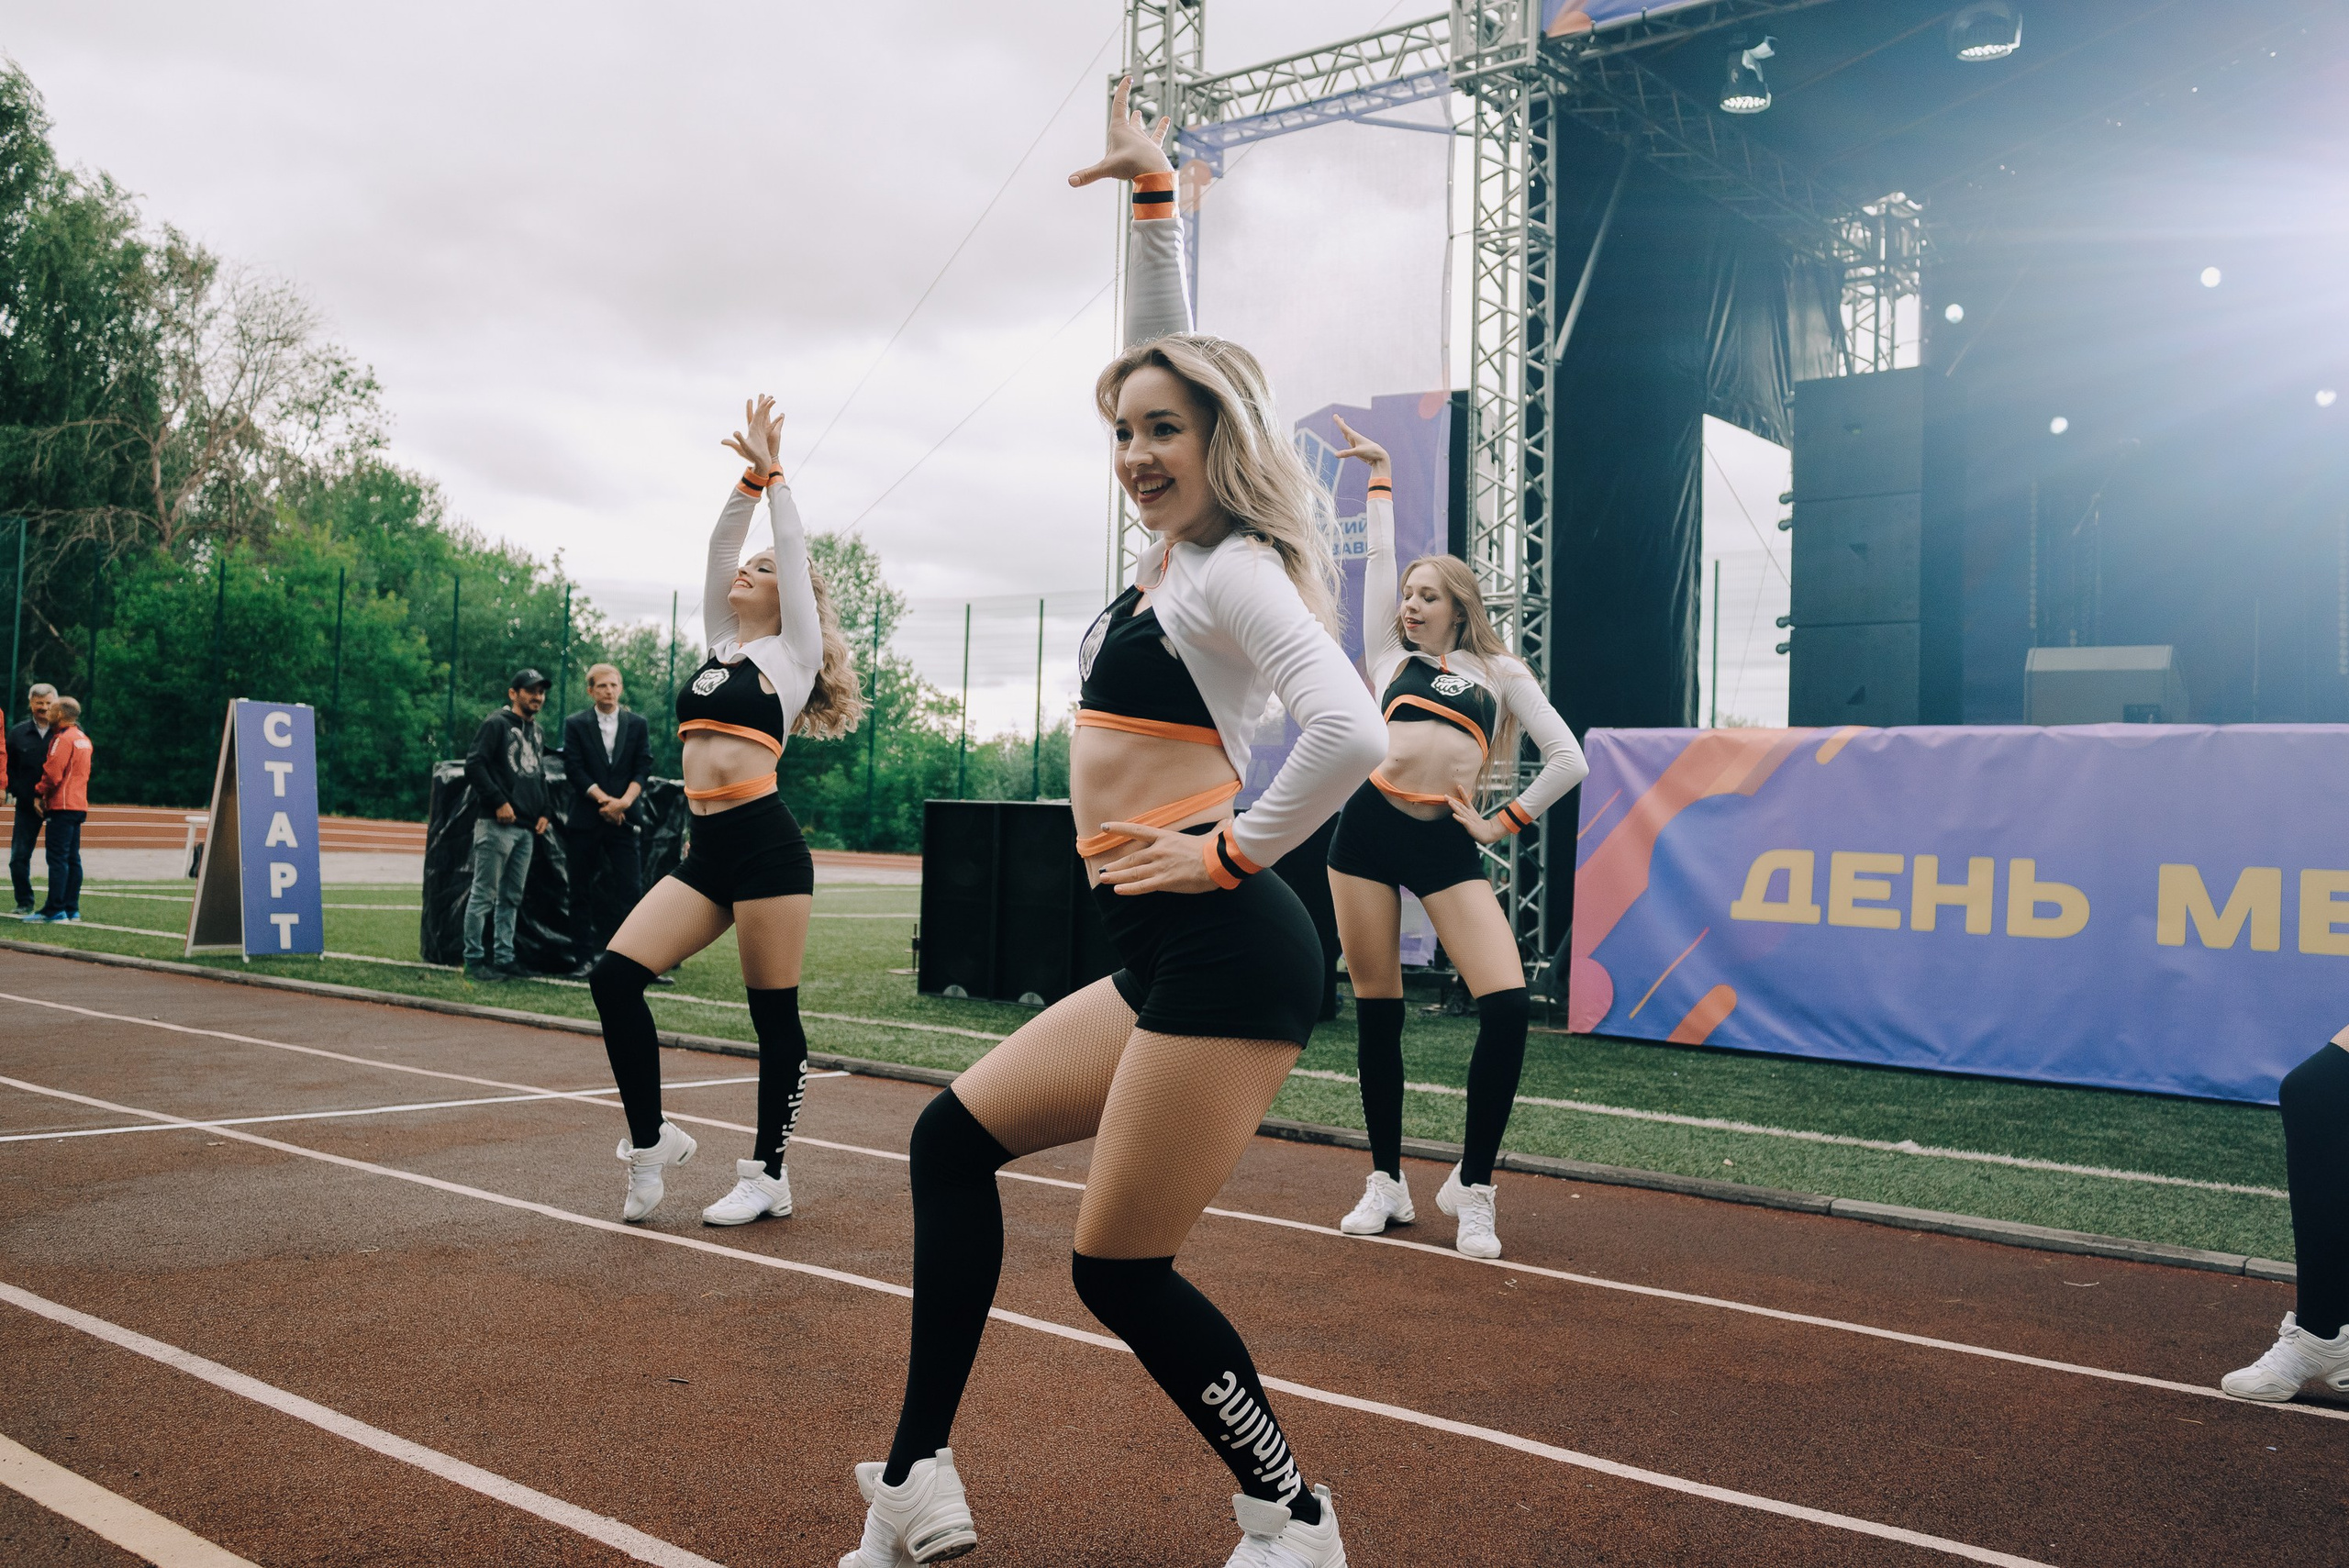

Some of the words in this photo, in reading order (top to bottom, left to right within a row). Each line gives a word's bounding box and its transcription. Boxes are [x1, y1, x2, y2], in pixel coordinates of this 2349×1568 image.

[263, 711, 299, 950] СТАРТ
[1730, 849, 2091, 939] ДЕНЬ
[2156, 863, 2349, 956] МЕ
[1201, 1371, 1302, 1507] Winline
